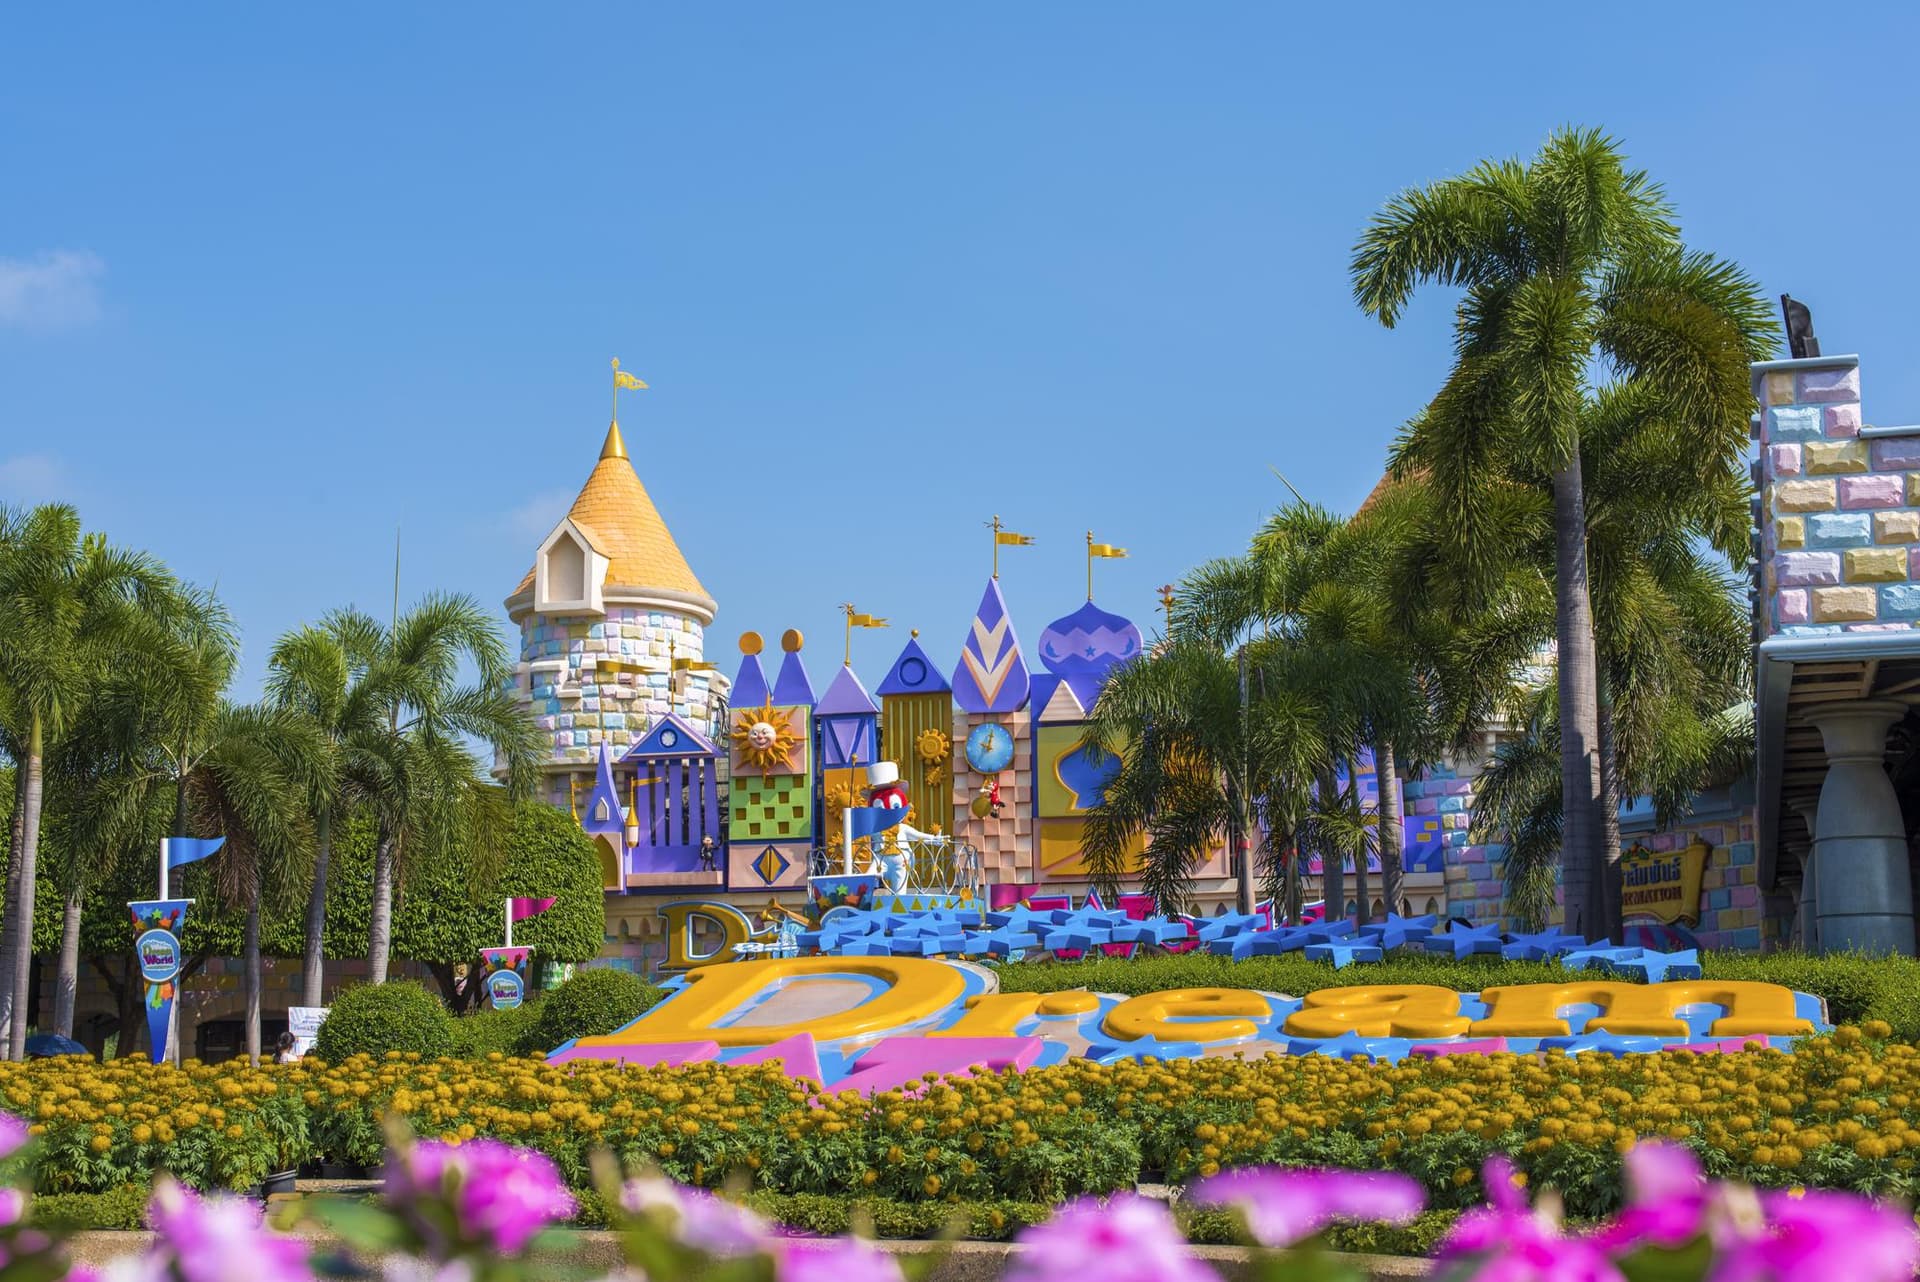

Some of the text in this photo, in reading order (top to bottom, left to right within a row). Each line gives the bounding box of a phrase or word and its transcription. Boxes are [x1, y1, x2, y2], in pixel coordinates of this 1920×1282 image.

[1623, 886, 1682, 906] RMATION
[144, 954, 174, 964] World
[575, 955, 1816, 1046] Dream
